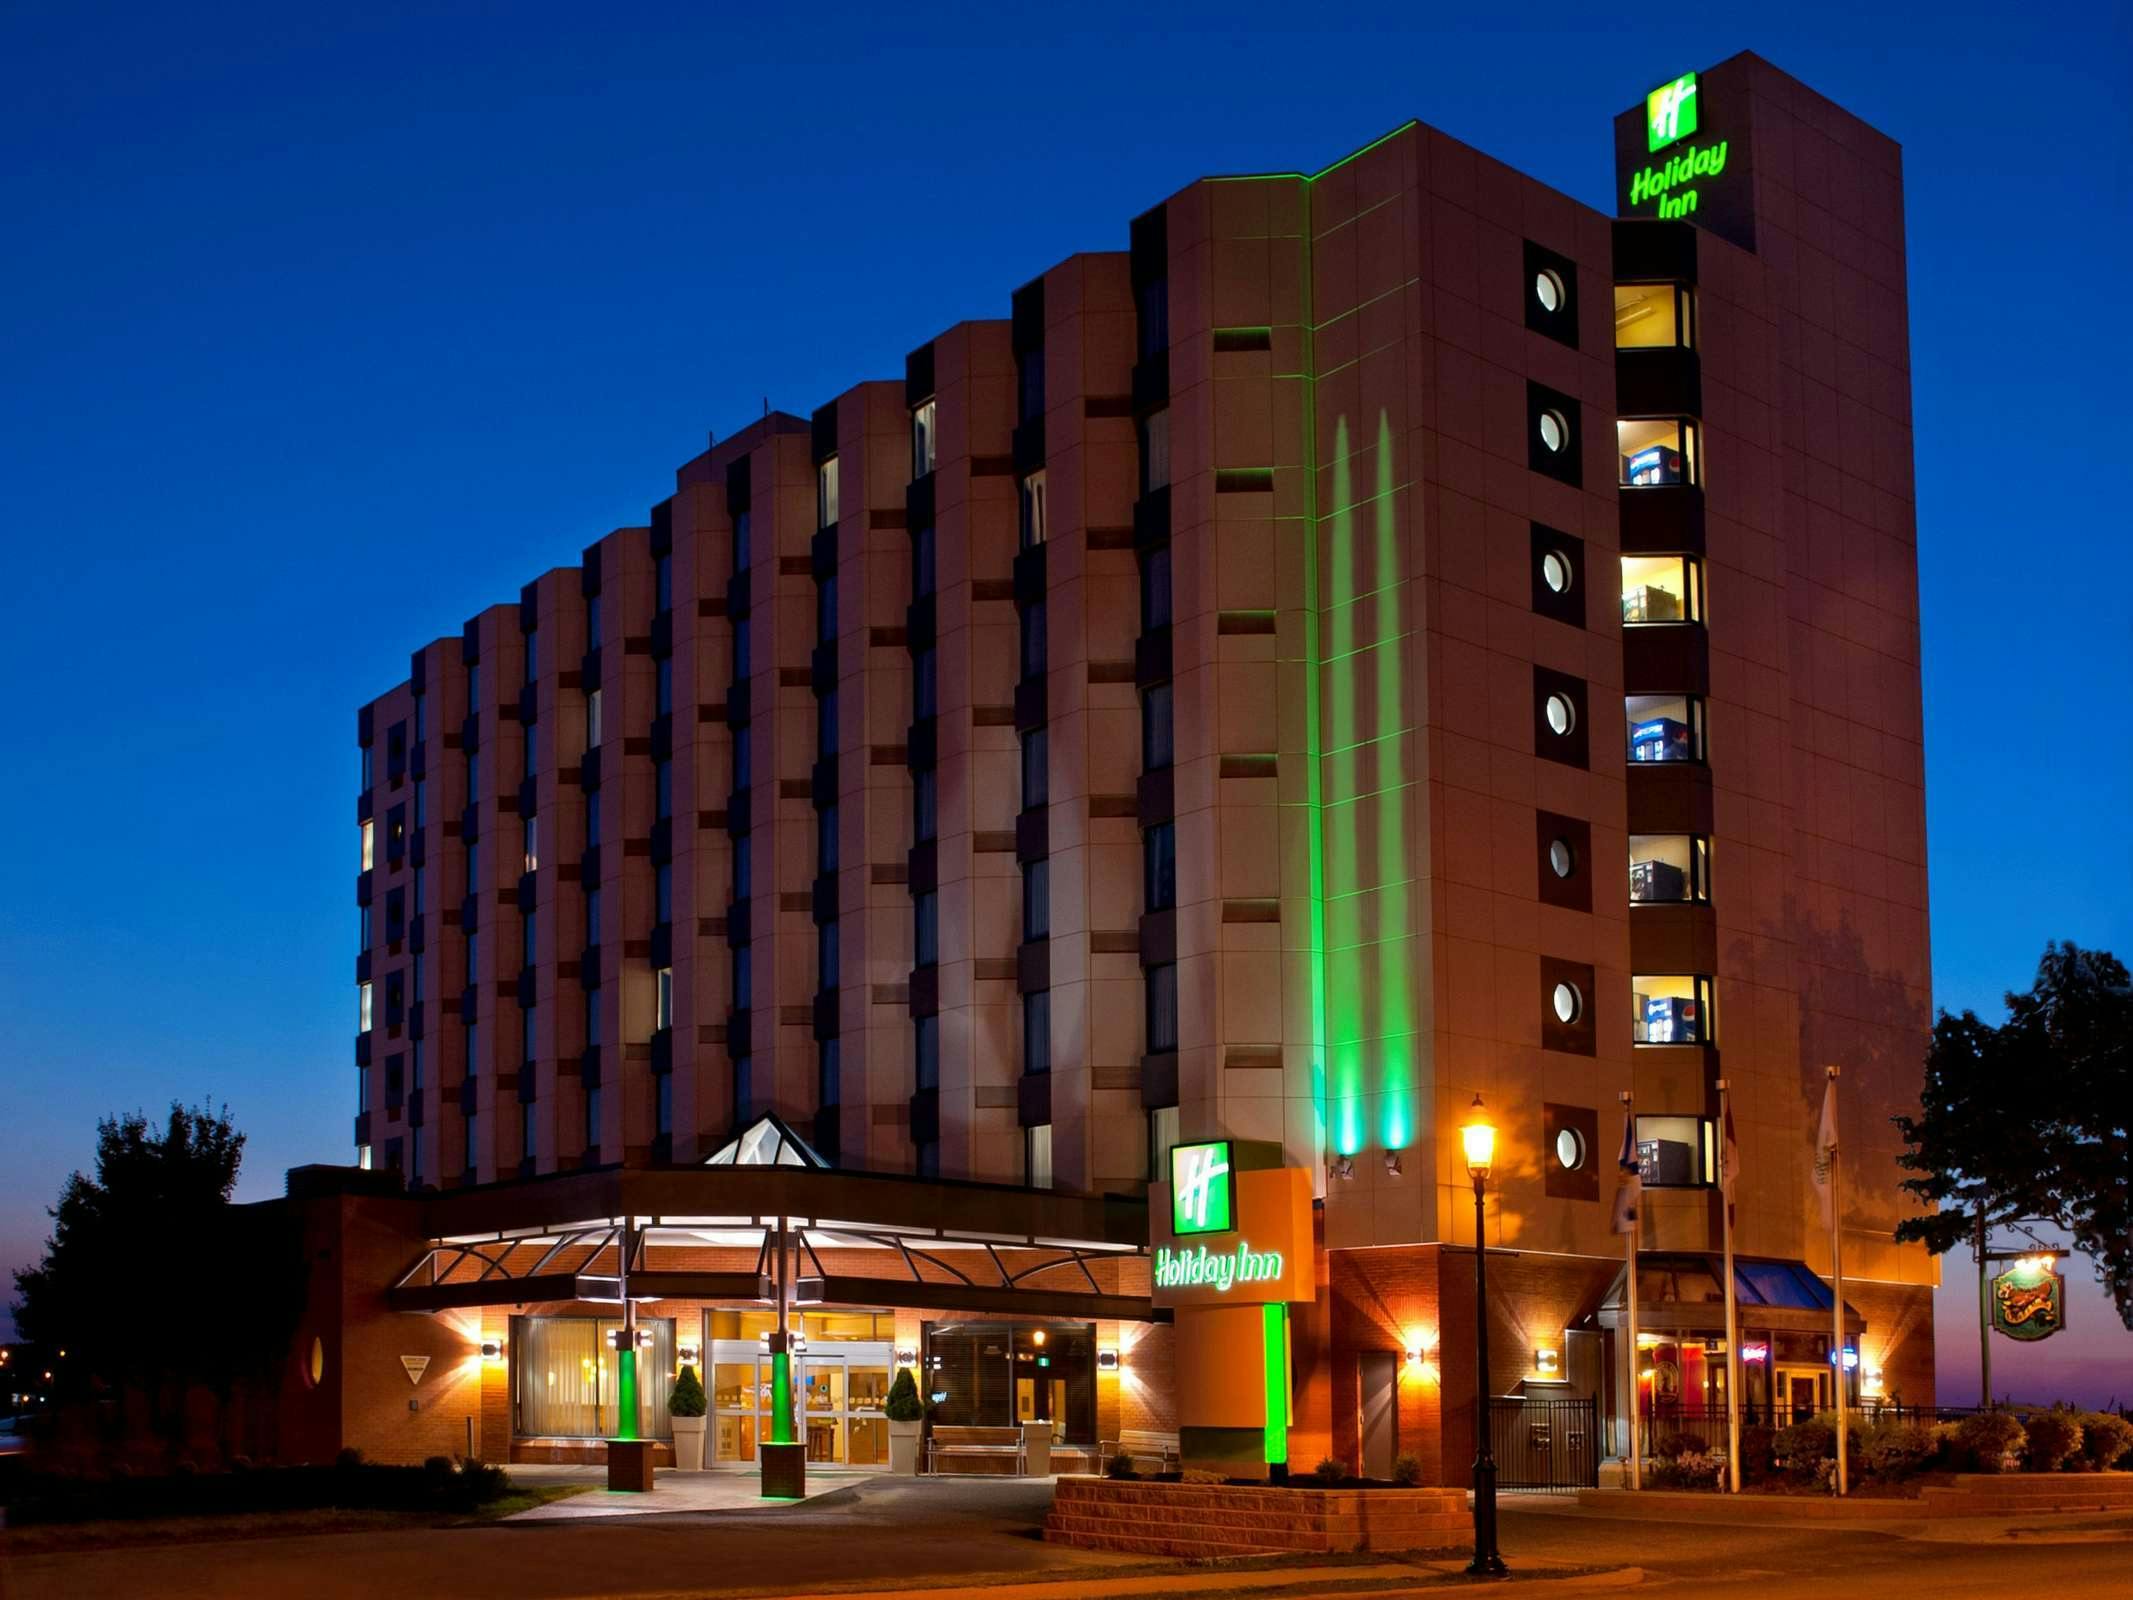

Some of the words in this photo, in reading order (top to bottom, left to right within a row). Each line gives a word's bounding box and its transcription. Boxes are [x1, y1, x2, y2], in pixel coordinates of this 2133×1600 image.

[1630, 141, 1728, 206] Holiday
[1658, 190, 1698, 219] Inn
[1155, 1245, 1236, 1291] Holiday
[1236, 1241, 1283, 1282] Inn
